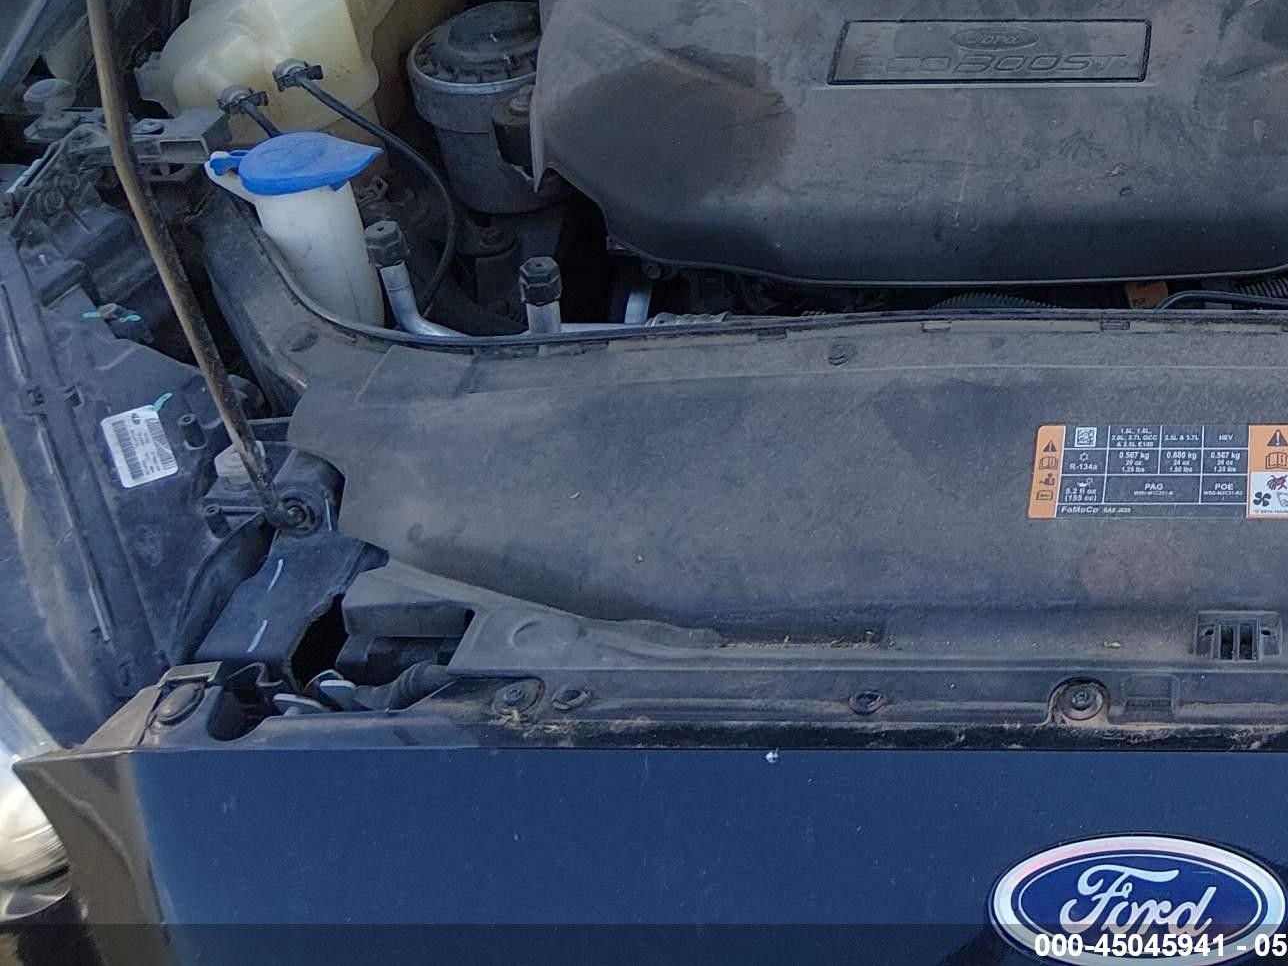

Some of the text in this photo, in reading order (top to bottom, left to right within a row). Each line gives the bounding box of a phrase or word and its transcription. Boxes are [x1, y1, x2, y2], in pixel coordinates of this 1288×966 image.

[1140, 451, 1149, 460] kg
[1188, 451, 1197, 460] kg
[1231, 451, 1240, 460] kg
[1144, 483, 1164, 491] PAG
[1214, 483, 1234, 491] POE
[1060, 864, 1217, 935] Ford
